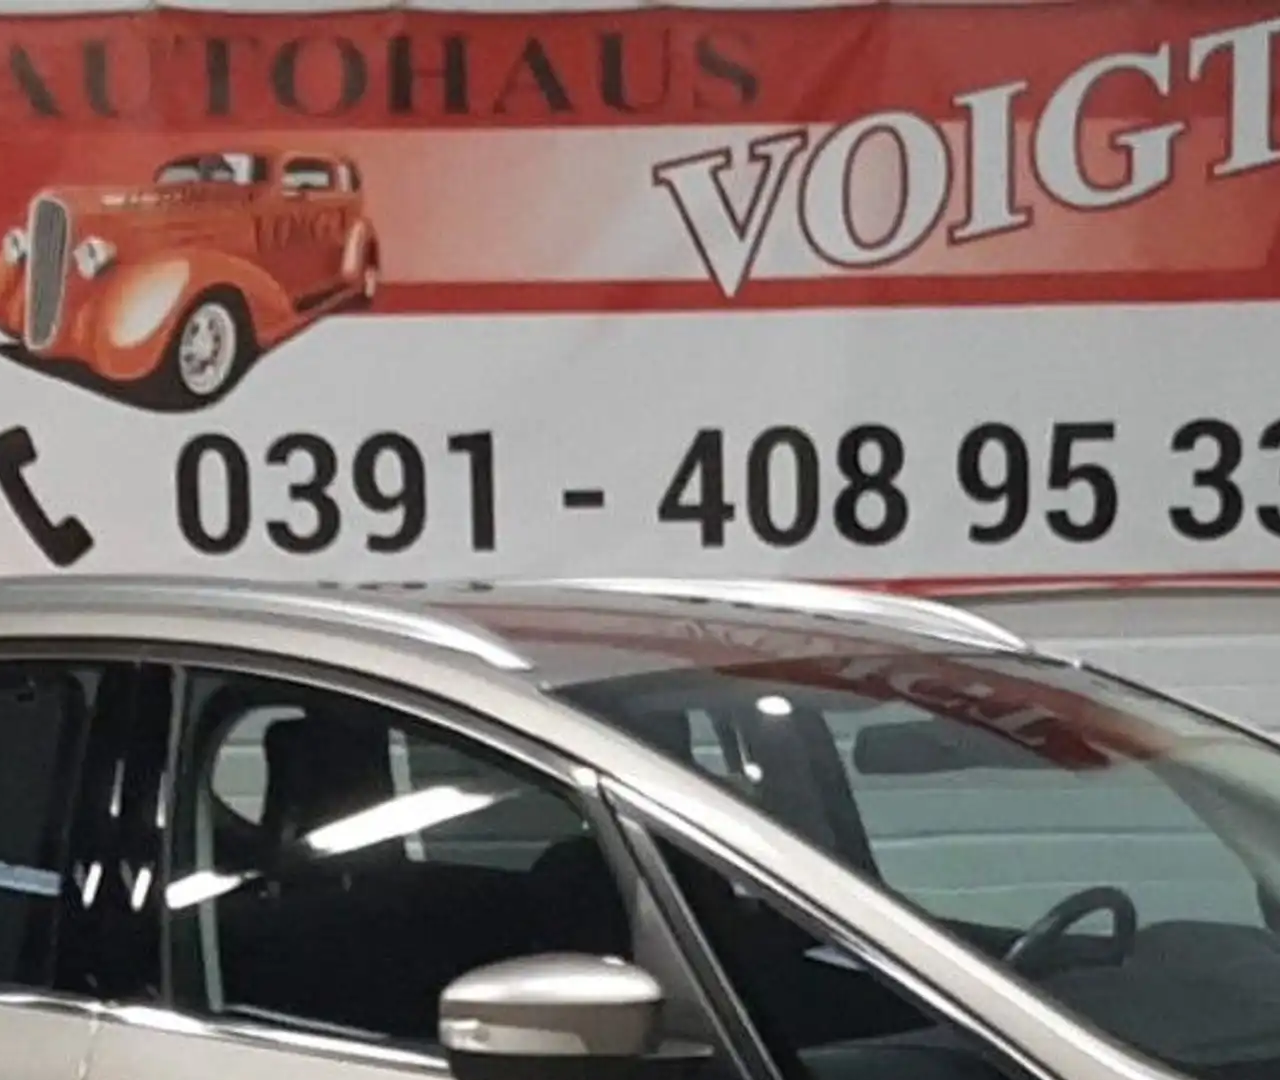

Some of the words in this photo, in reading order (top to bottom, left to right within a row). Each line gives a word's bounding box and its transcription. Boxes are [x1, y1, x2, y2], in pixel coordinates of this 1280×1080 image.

[175, 430, 498, 555] 0391
[562, 488, 606, 509] -
[657, 424, 910, 549] 408
[956, 422, 1119, 545] 95
